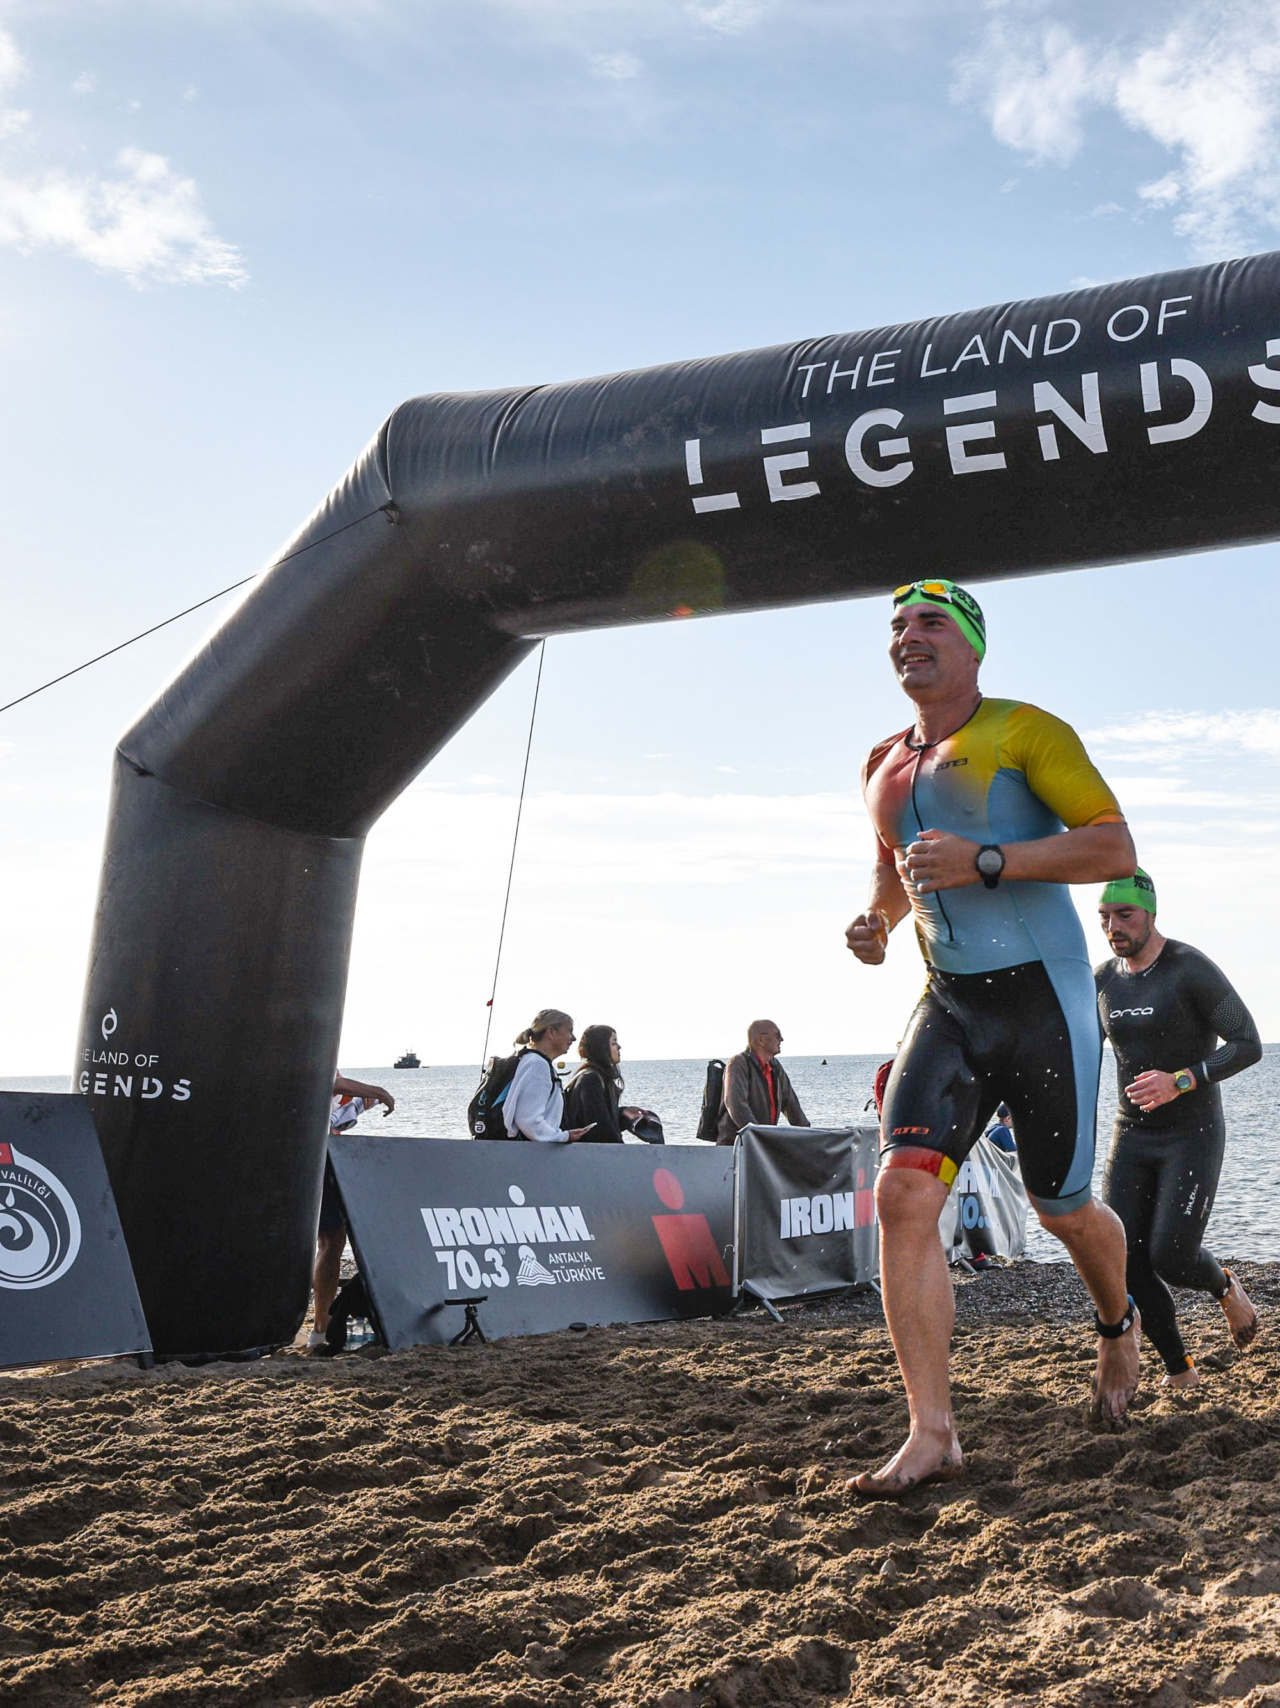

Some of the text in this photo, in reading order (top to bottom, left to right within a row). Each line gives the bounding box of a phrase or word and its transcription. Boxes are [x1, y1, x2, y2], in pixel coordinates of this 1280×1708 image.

[798, 296, 1192, 398] THE LAND OF
[1109, 1006, 1154, 1019] orca
[92, 1050, 129, 1066] LAND
[134, 1054, 160, 1068] OF
[420, 1205, 591, 1247] IRONMAN
[548, 1251, 592, 1265] ANTALYA
[435, 1247, 510, 1290] 70.3
[552, 1265, 606, 1284] TÜRKİYE
